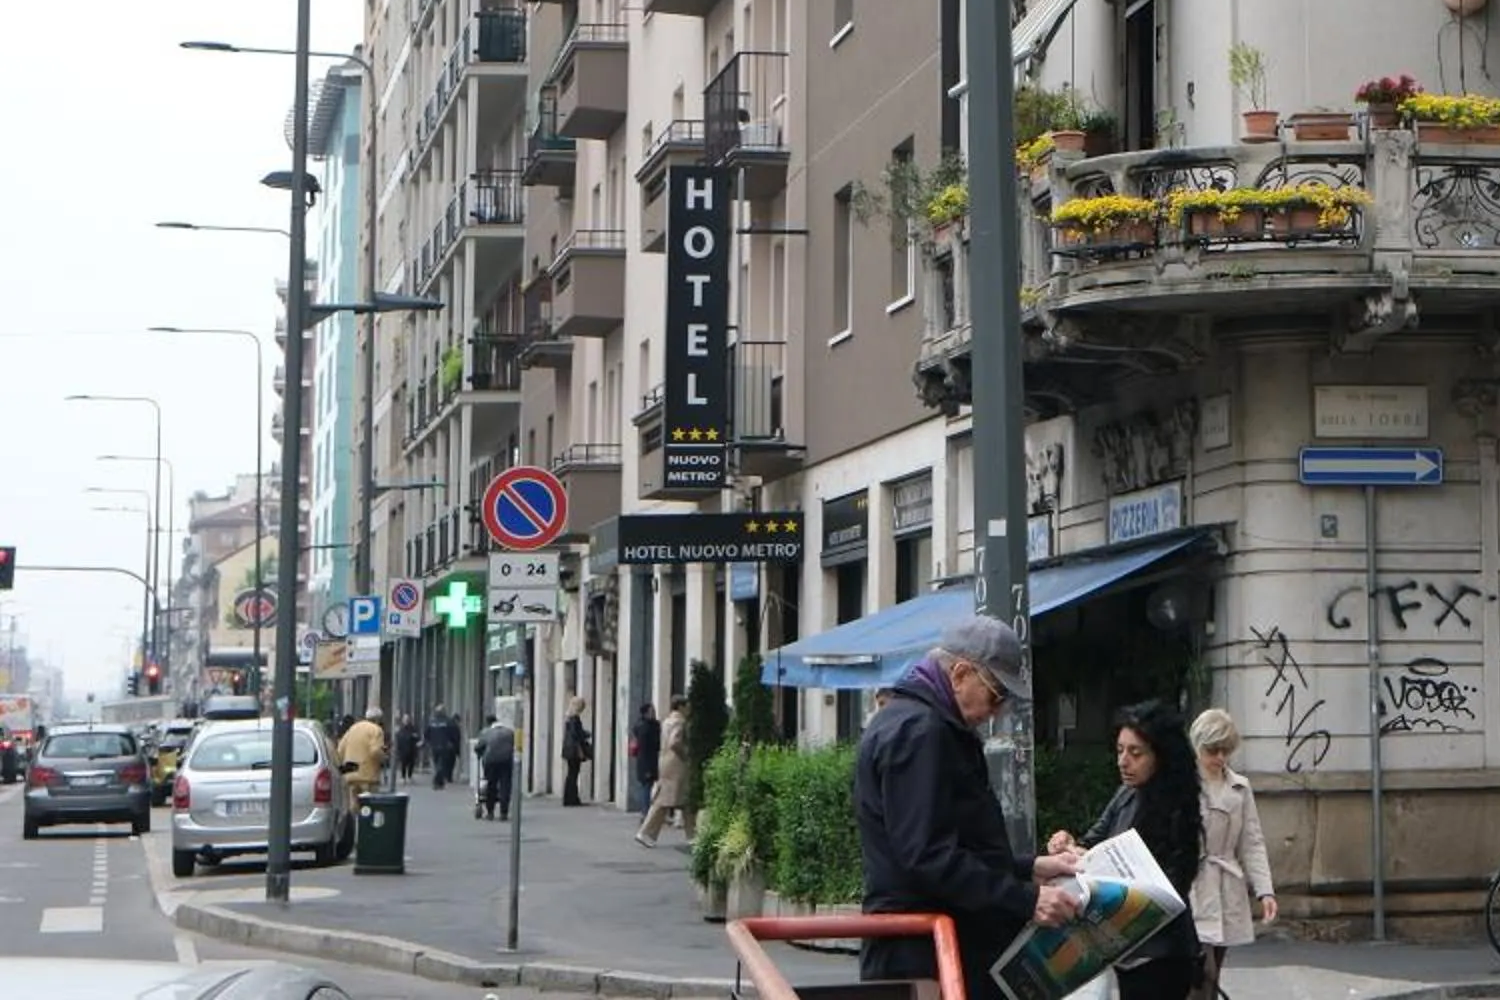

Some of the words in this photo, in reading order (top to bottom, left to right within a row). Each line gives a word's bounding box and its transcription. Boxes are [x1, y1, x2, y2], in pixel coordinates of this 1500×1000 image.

[683, 177, 713, 406] HOTEL
[668, 455, 720, 465] NUOVO
[625, 546, 675, 559] HOTEL
[679, 544, 737, 558] NUOVO
[501, 563, 511, 576] 0
[527, 563, 546, 576] 24
[353, 600, 375, 632] P
